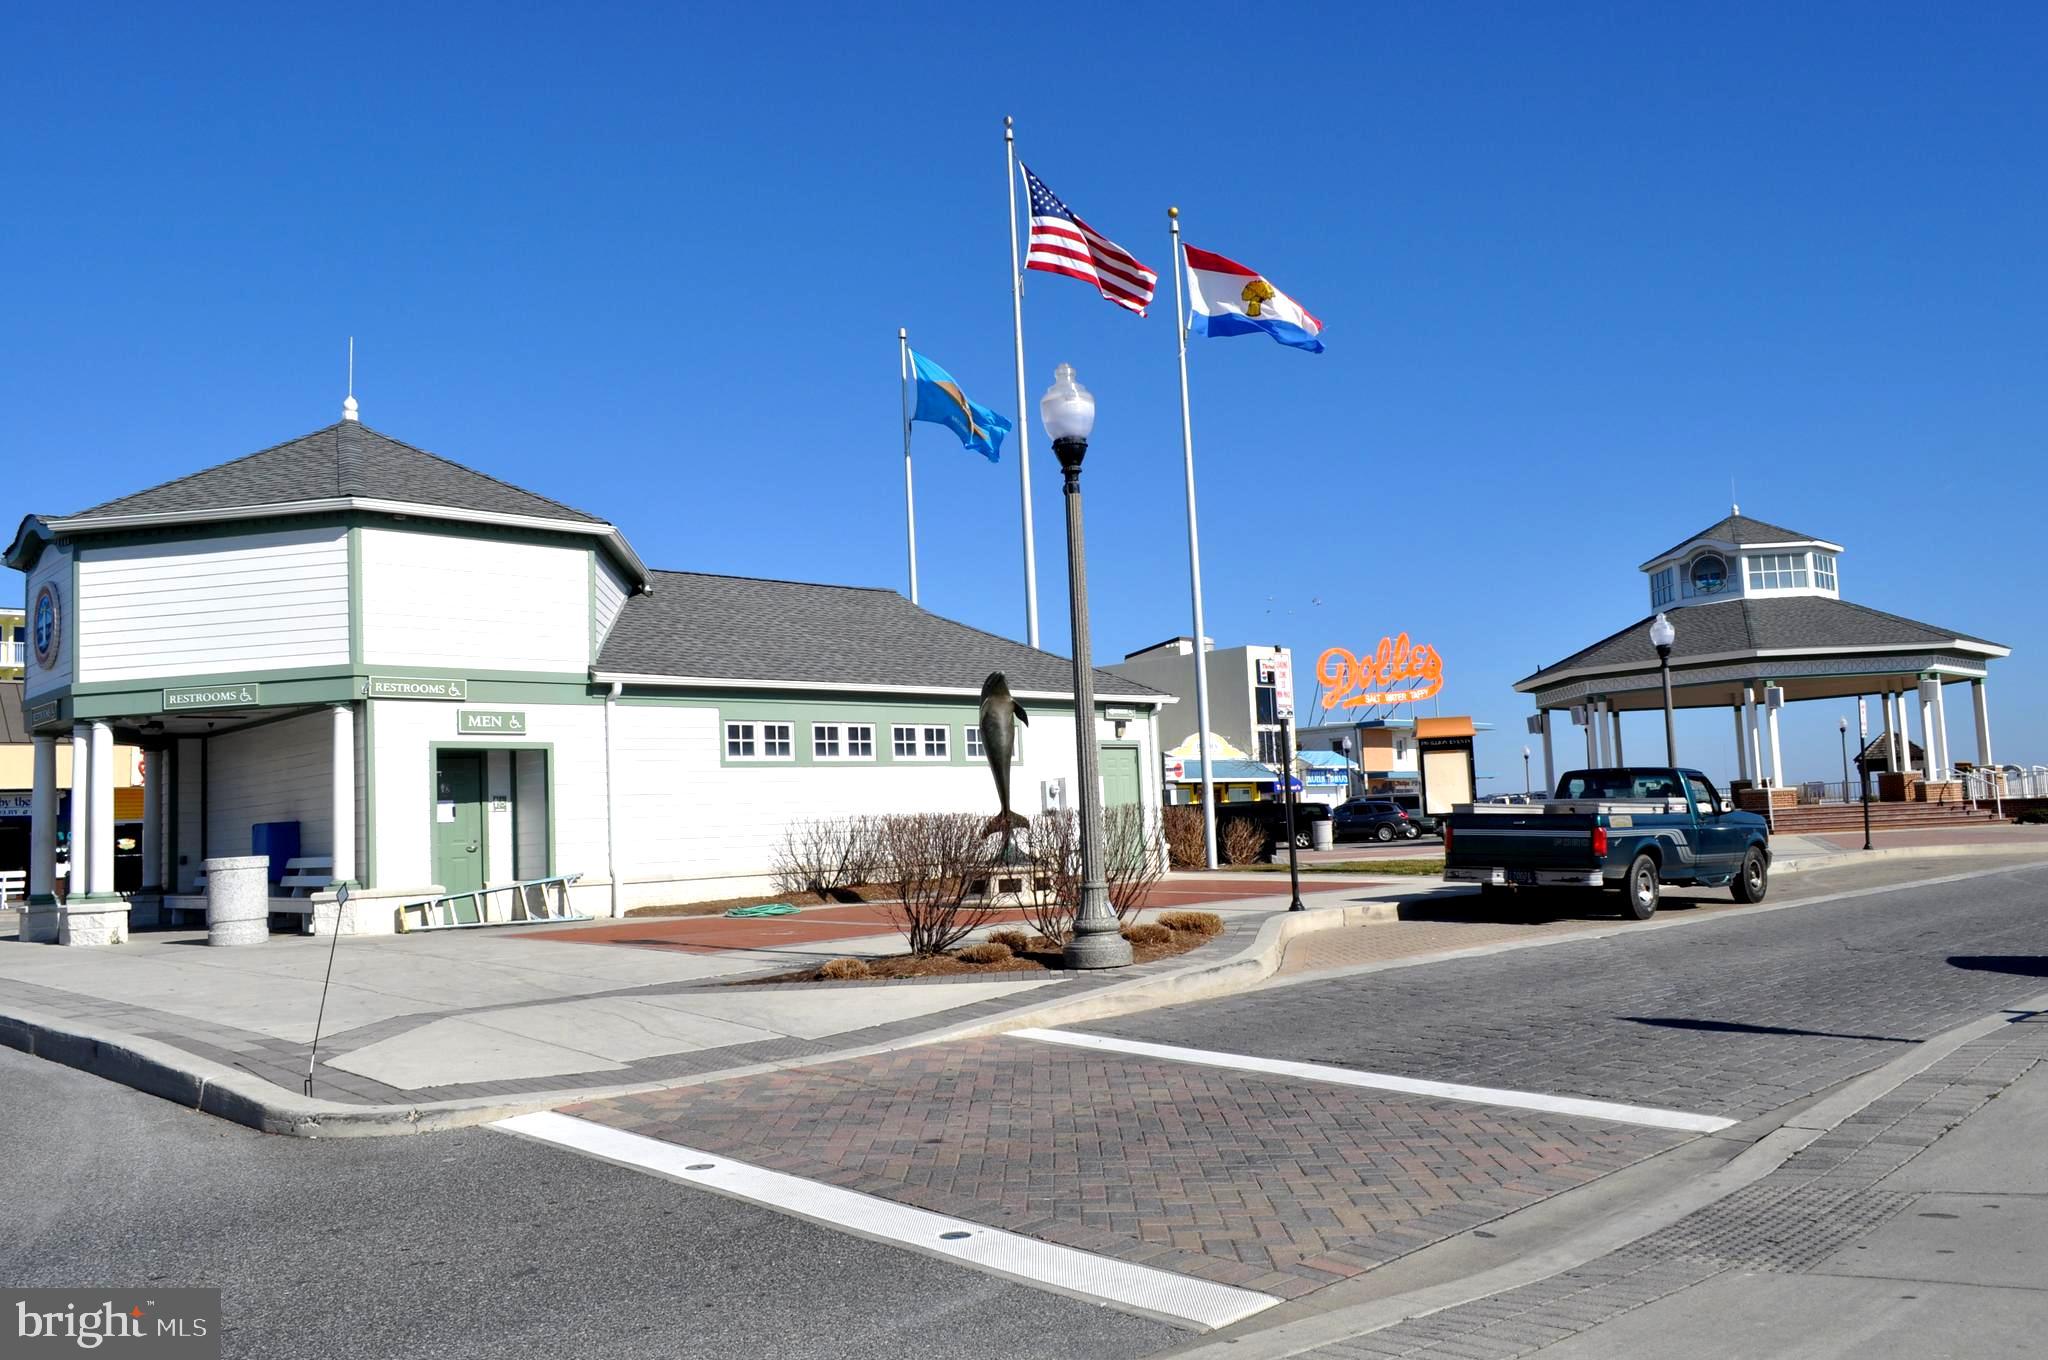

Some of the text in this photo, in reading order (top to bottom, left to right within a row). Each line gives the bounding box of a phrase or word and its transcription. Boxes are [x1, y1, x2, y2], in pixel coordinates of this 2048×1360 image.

[375, 682, 445, 694] RESTROOMS
[169, 691, 237, 704] RESTROOMS
[1365, 689, 1429, 703] SALT WATER TAFFY
[468, 715, 502, 727] MEN
